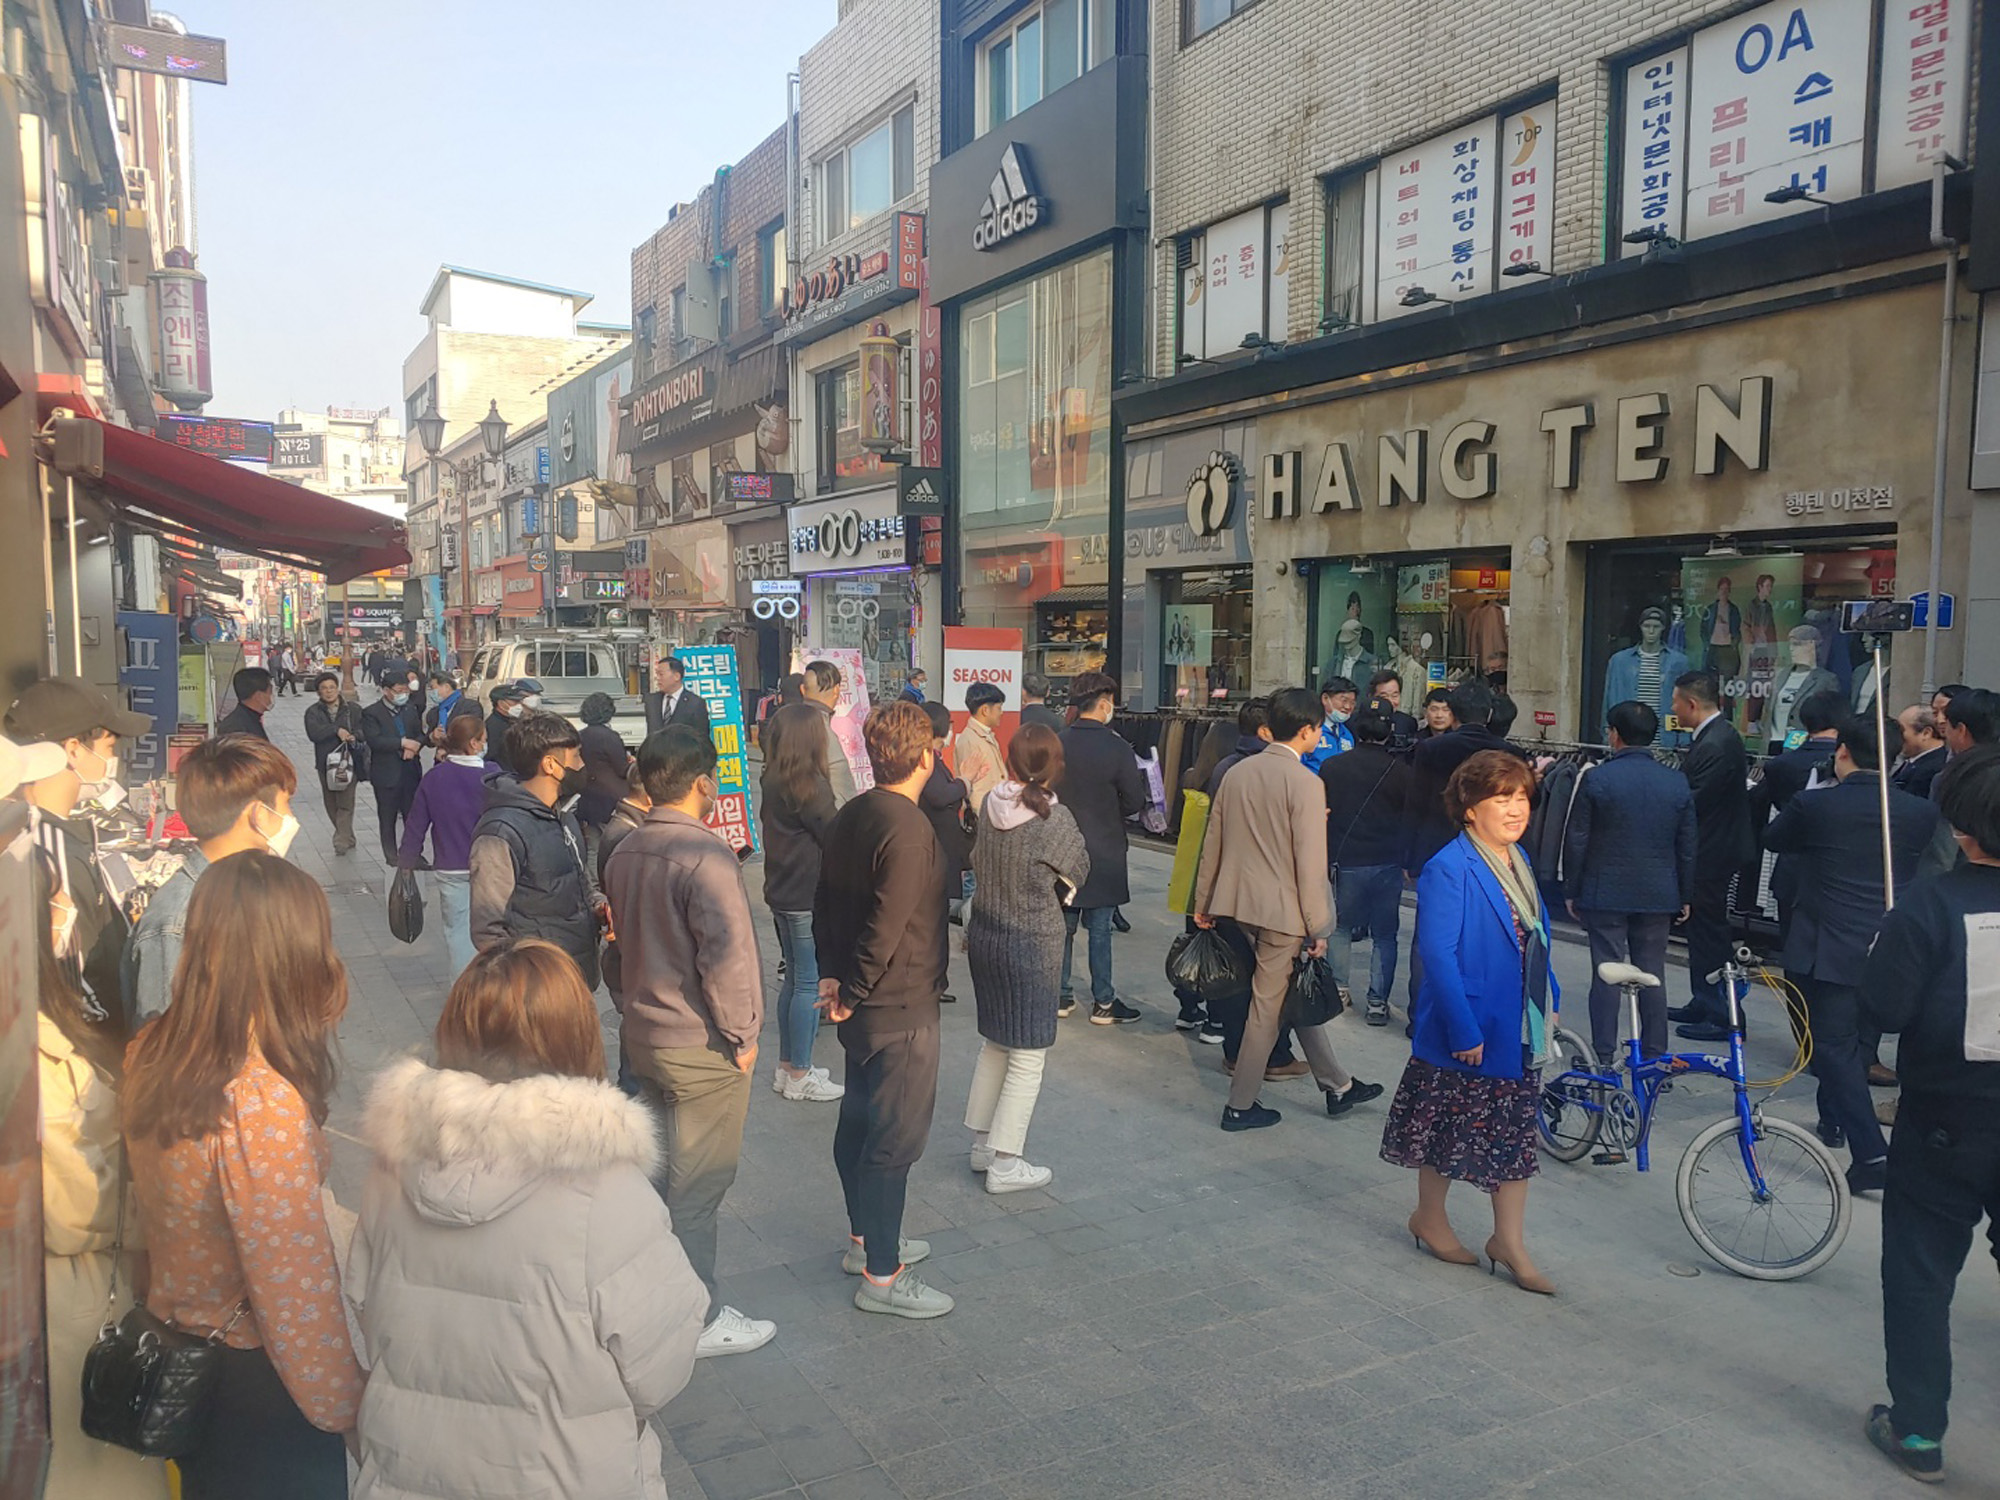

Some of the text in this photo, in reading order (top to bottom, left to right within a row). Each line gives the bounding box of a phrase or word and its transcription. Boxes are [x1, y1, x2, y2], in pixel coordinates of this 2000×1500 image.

[1735, 8, 1814, 74] OA
[1515, 125, 1542, 146] TOP
[1789, 71, 1834, 193] 스캐너
[1708, 96, 1747, 216] 프린터
[973, 196, 1038, 251] adidas
[1451, 137, 1480, 292] 화상채팅통신
[904, 217, 918, 287] 슈노아이
[1276, 243, 1289, 256] TO
[1212, 254, 1228, 287] 사이버
[163, 283, 193, 384] 조앤리
[633, 366, 704, 427] DOHTONBORI
[922, 308, 937, 467] しゅのあい
[280, 454, 312, 464] HOTEL
[1263, 376, 1772, 520] HANG TEN
[905, 493, 939, 503] adidas
[1785, 486, 1895, 516] 행텐 이천점
[595, 581, 625, 597] 시계
[366, 608, 396, 617] SQUARE
[682, 653, 731, 677] 신도림
[952, 668, 1012, 684] SEASON
[707, 699, 727, 719] 트
[706, 796, 743, 826] 가입
